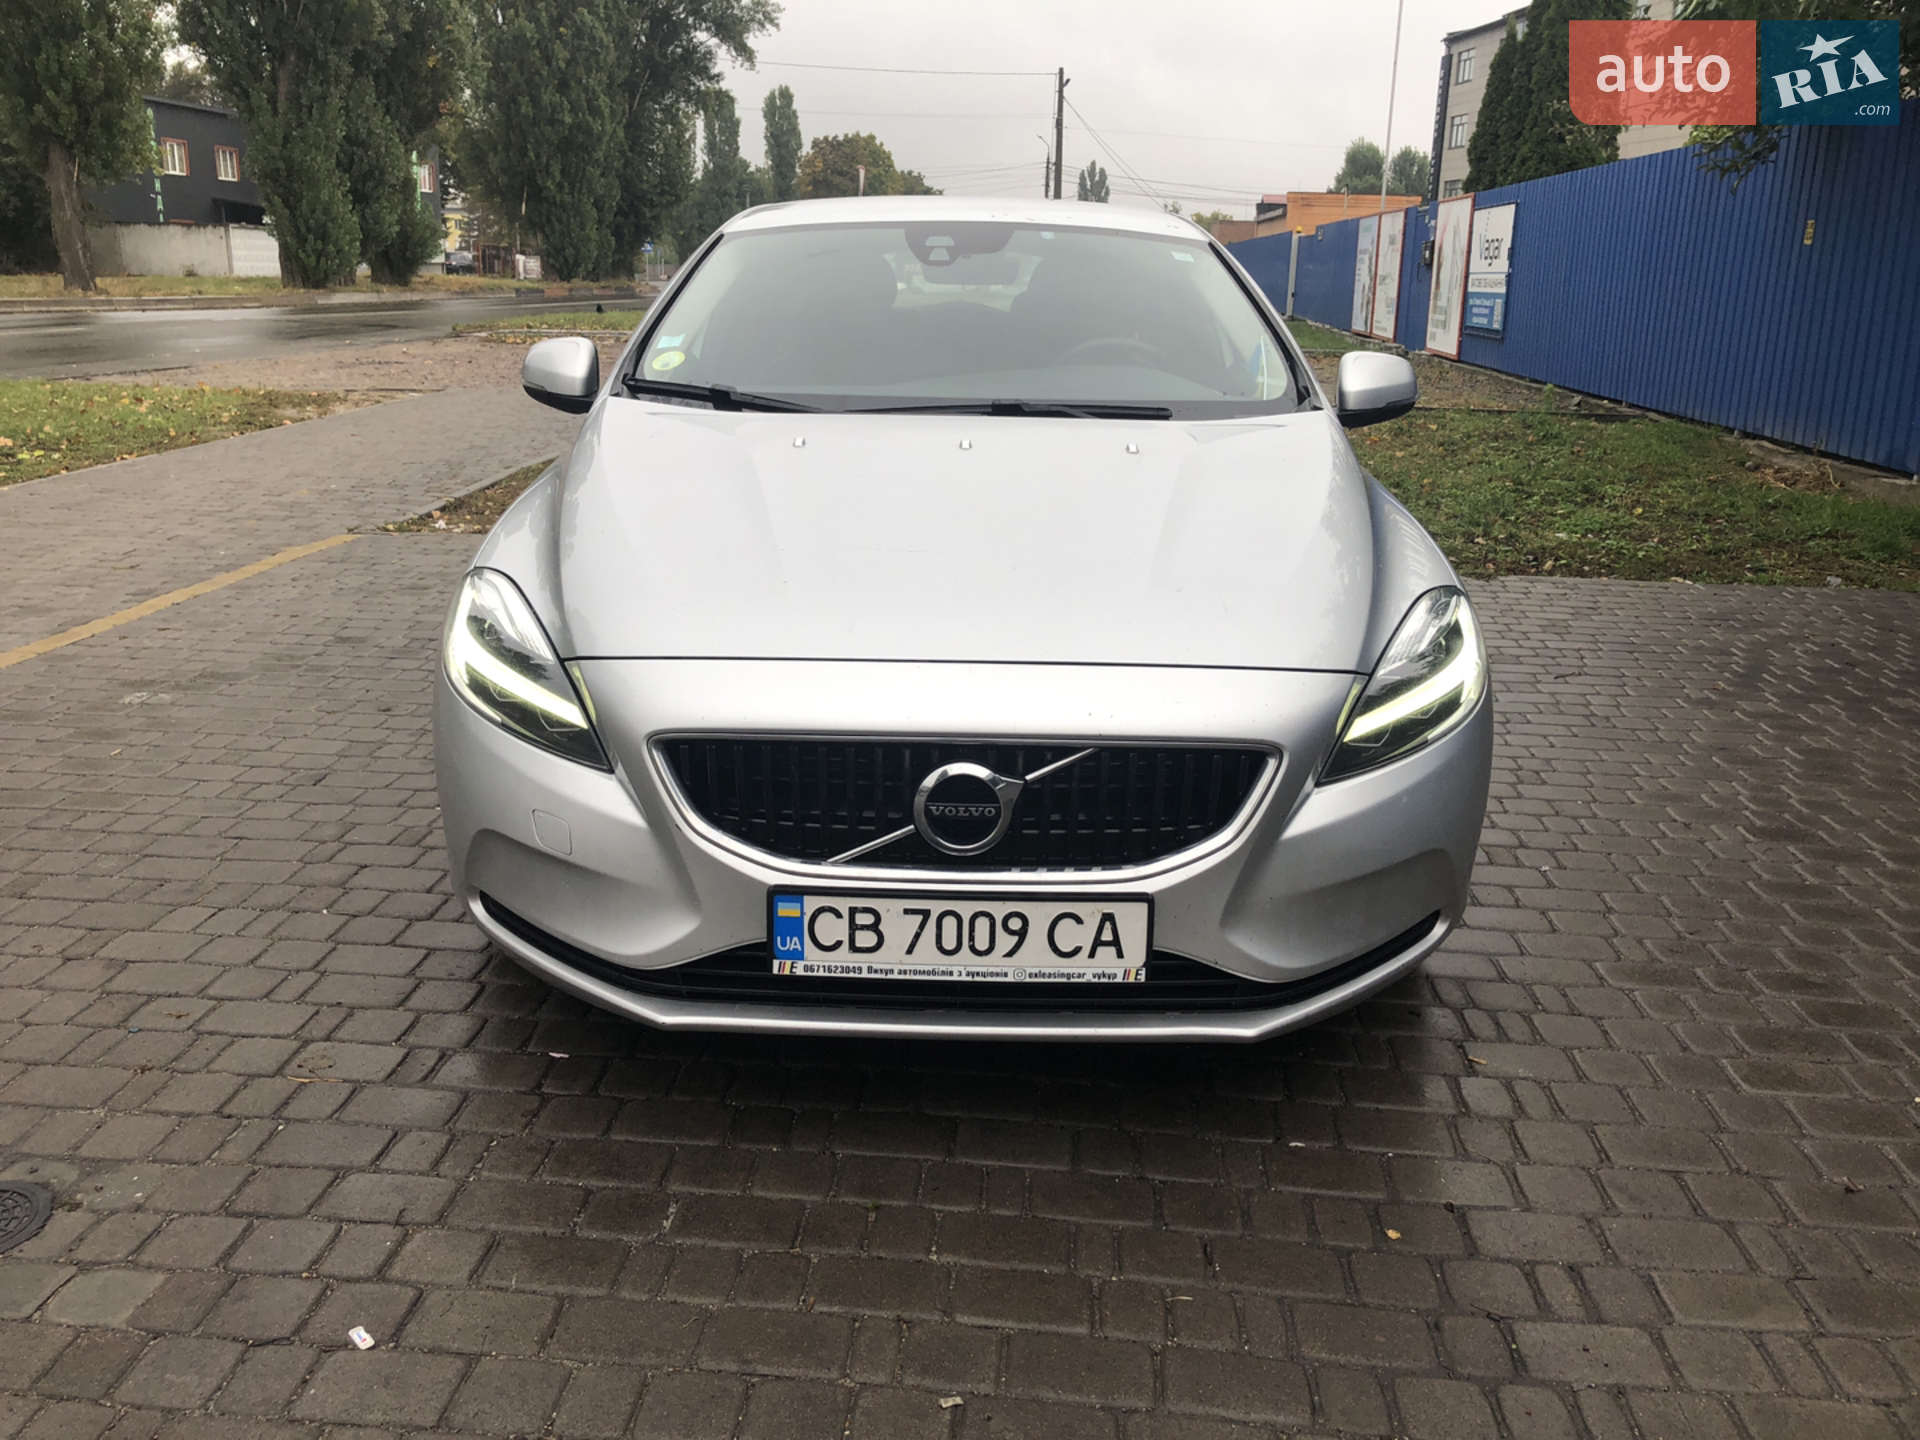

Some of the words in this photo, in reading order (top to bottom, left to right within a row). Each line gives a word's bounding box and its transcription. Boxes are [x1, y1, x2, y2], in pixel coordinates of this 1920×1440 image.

[1479, 233, 1503, 267] Vagar
[928, 806, 996, 817] VOLVO
[807, 905, 885, 953] CB
[902, 907, 1030, 958] 7009
[1047, 911, 1125, 959] CA
[776, 935, 802, 952] UA
[803, 963, 863, 975] 0671623049
